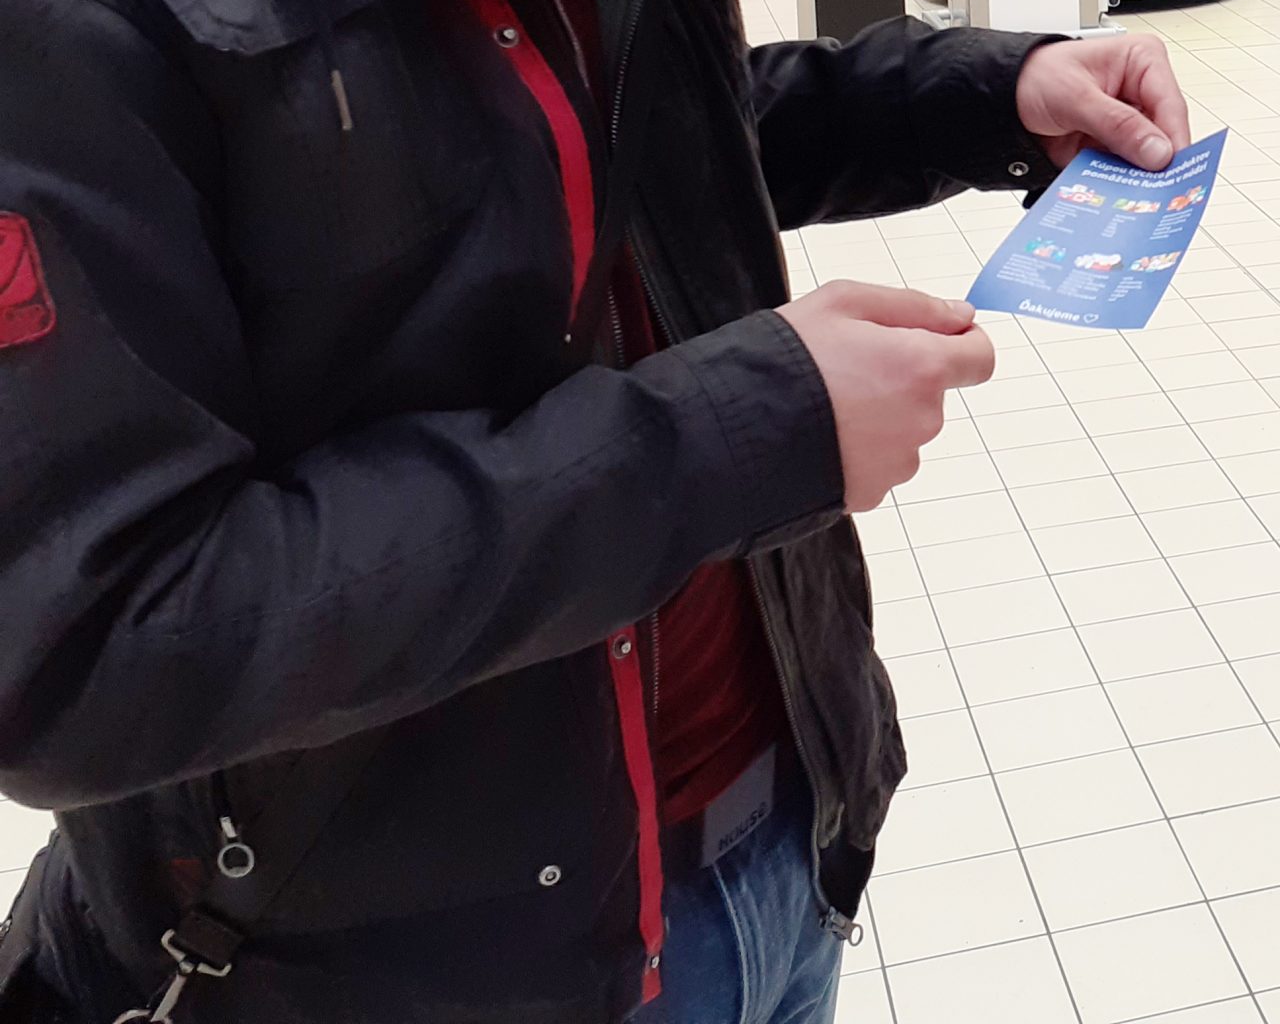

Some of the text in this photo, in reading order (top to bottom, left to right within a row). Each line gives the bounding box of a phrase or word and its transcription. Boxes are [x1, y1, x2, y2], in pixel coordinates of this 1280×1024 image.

[1090, 160, 1127, 173] Kúpou
[1081, 170, 1140, 186] pomôžete
[1019, 298, 1080, 321] Ďakujeme
